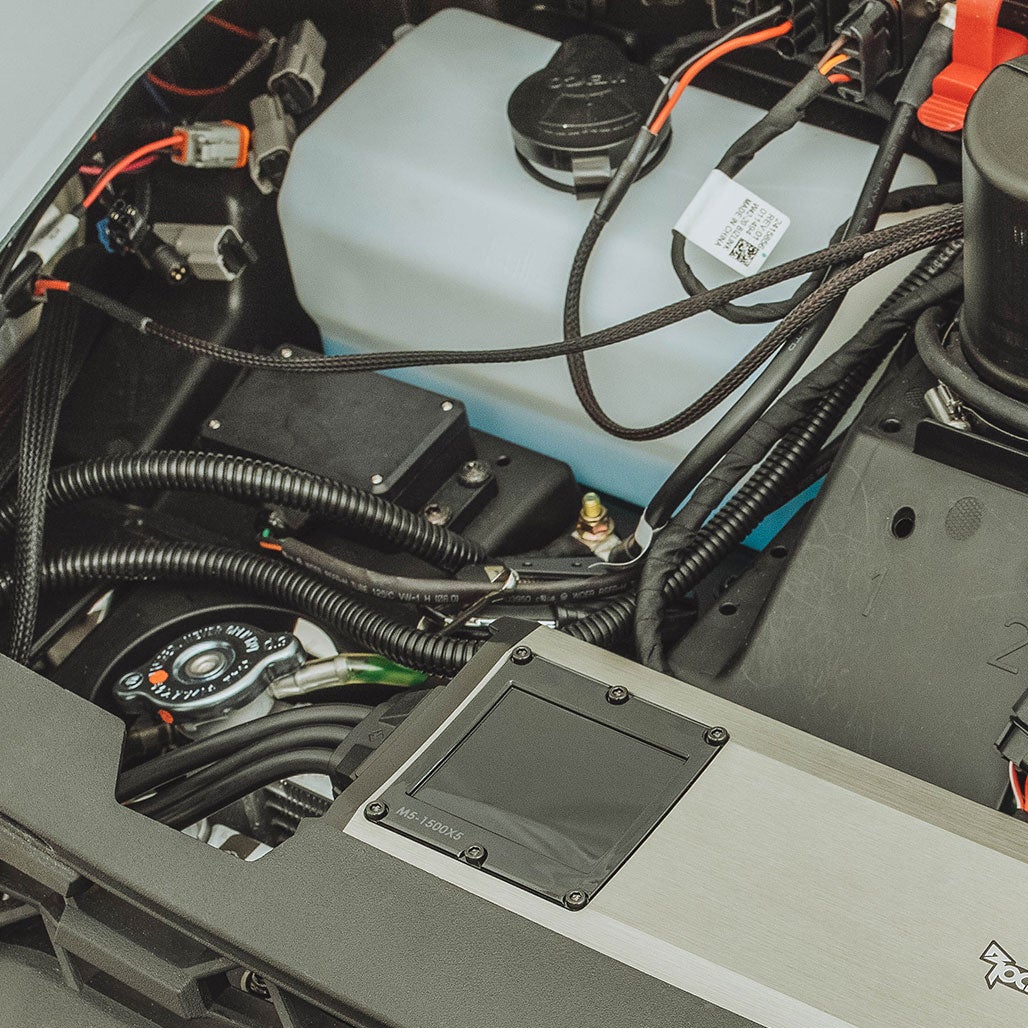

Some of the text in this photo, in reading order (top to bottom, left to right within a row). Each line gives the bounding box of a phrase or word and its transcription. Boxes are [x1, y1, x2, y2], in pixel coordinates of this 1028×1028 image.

[714, 197, 752, 247] MADE IN CHINA
[758, 212, 774, 231] REV
[396, 806, 464, 841] M5-1500X5
